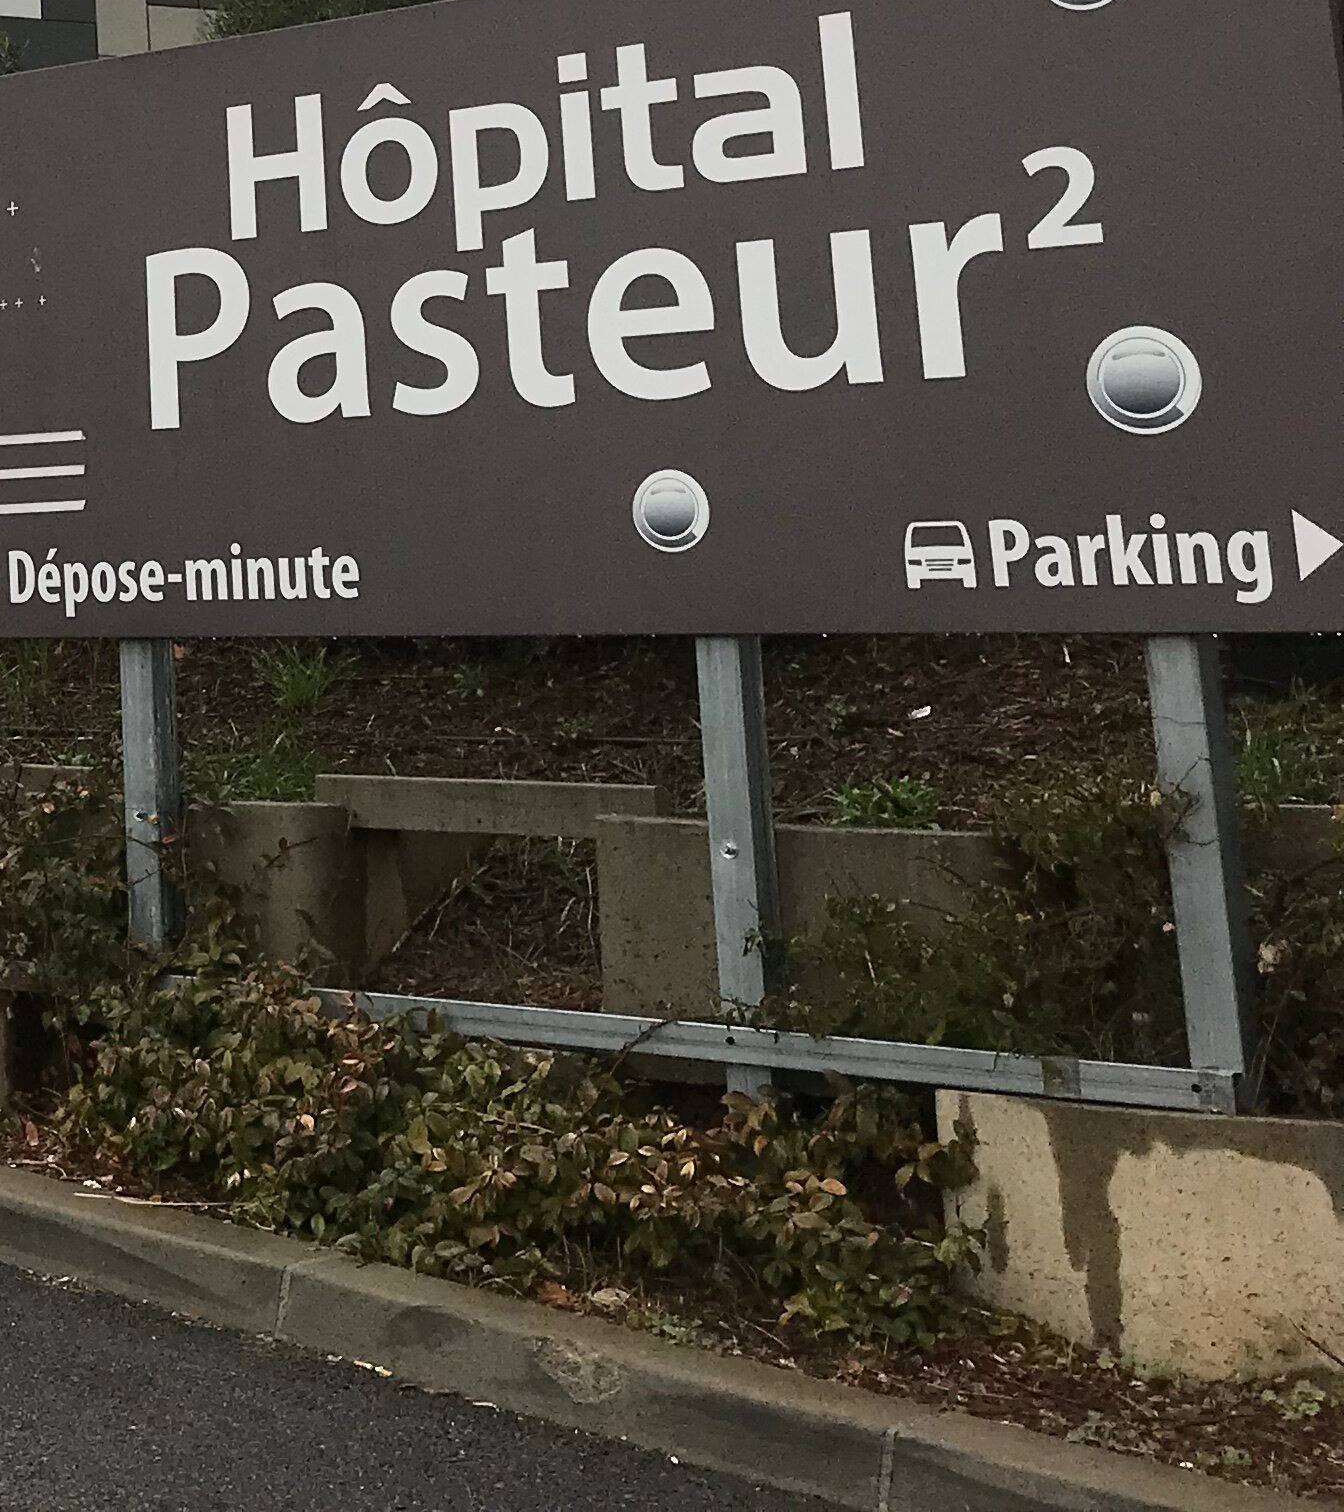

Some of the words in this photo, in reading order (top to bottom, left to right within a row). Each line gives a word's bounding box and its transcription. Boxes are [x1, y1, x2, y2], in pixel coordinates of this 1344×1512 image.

[226, 11, 865, 252] Hôpital
[8, 542, 360, 618] Dépose-minute
[988, 513, 1273, 604] Parking
